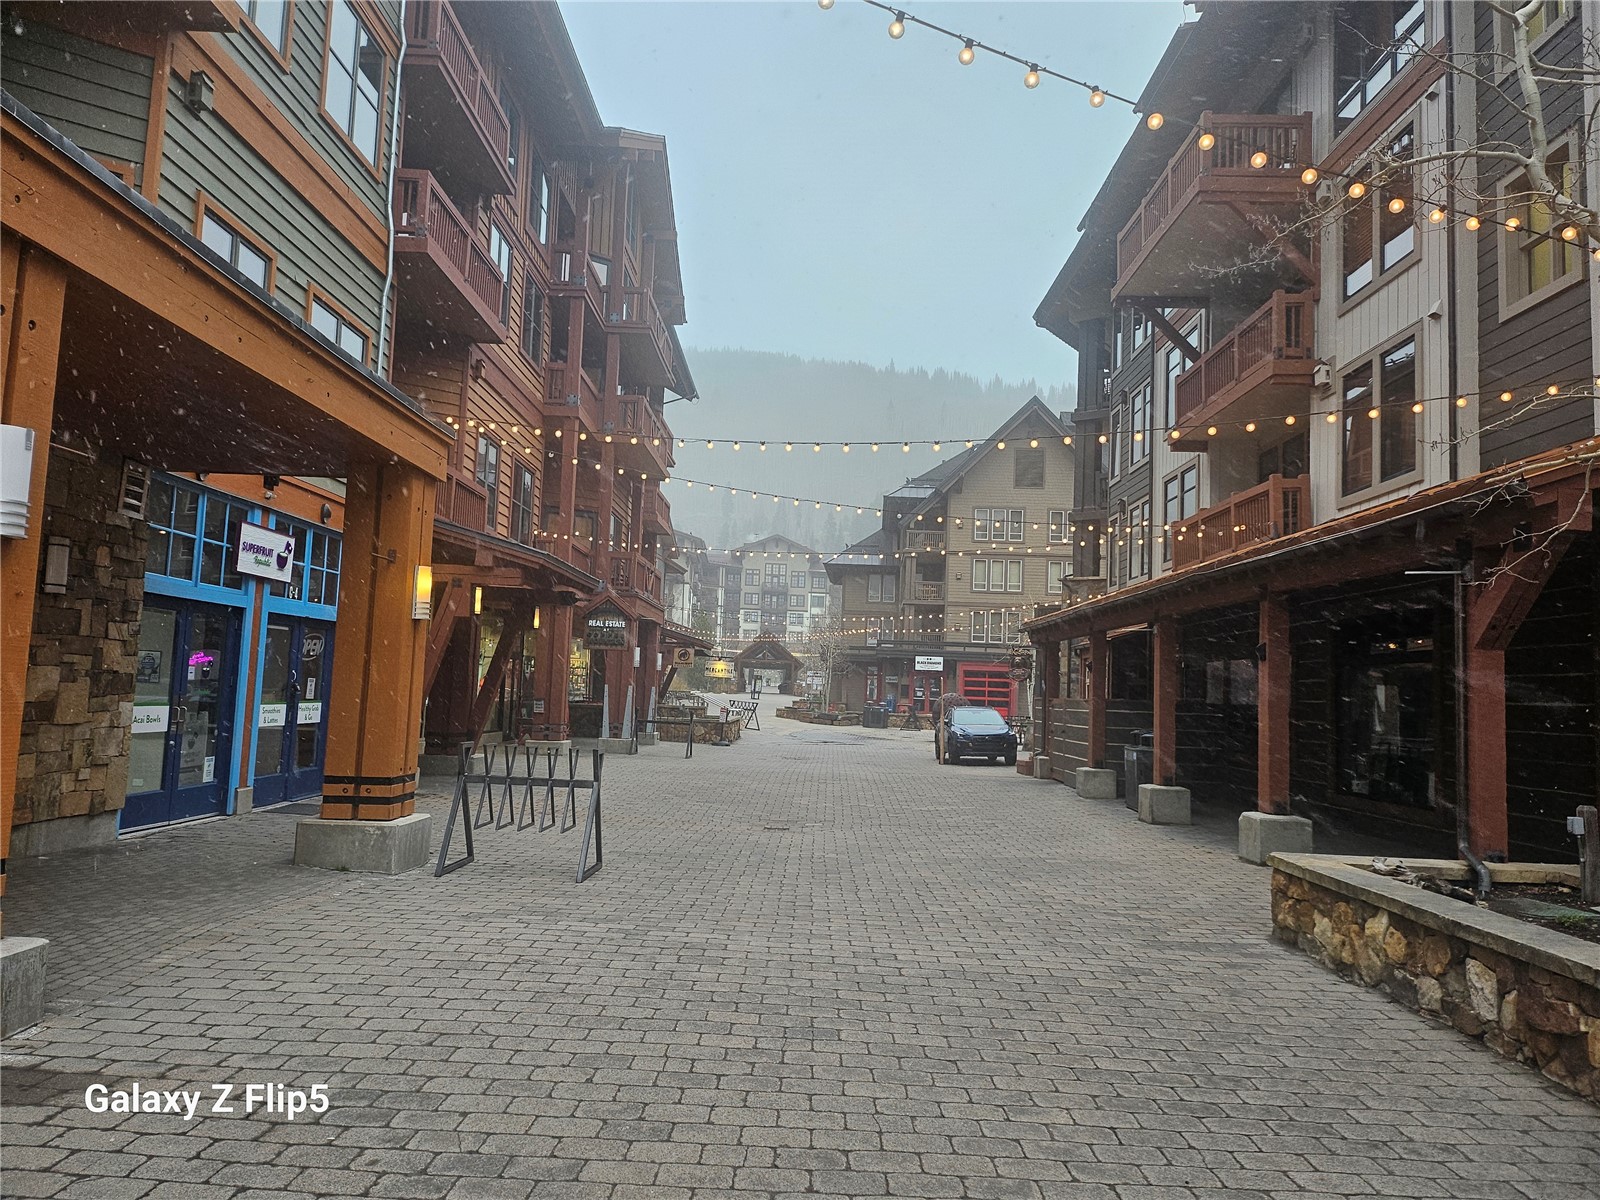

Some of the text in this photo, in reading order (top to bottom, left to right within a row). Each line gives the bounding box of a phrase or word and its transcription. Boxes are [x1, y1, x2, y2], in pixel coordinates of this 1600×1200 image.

[242, 541, 275, 558] SUPERFRUIT
[254, 555, 272, 568] Republic
[605, 620, 626, 628] ESTATE
[262, 706, 281, 714] Smoothies
[146, 714, 161, 724] Bowls
[267, 716, 279, 724] Lattes
